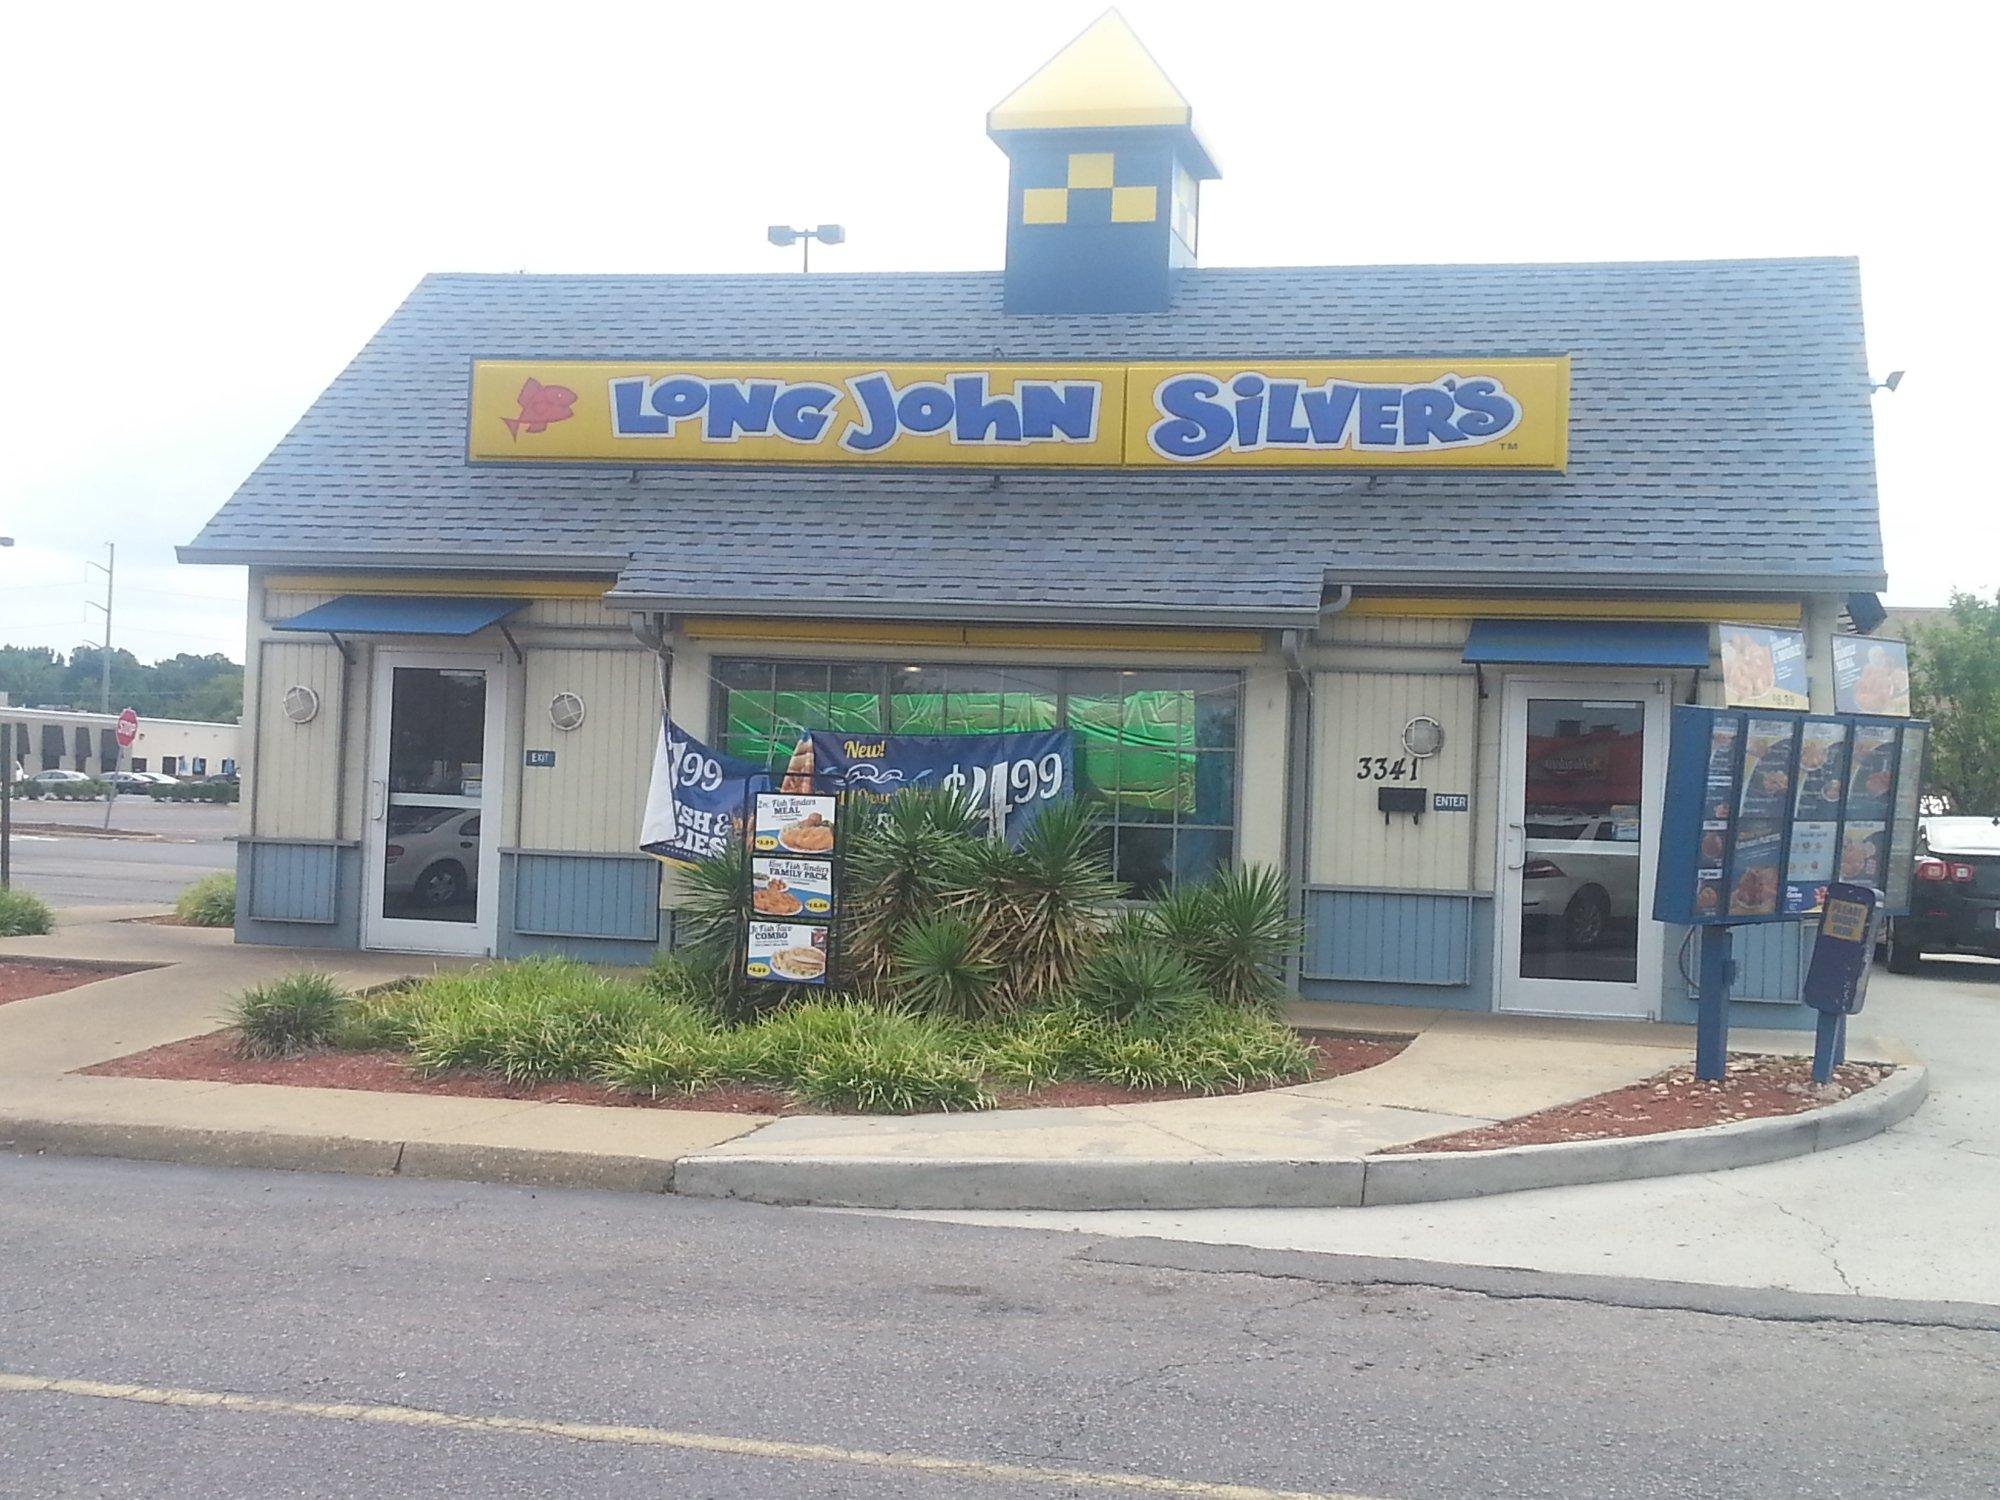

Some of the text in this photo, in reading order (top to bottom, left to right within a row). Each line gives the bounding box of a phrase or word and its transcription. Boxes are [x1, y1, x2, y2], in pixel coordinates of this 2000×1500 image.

[118, 719, 137, 736] STOP
[844, 740, 886, 759] New!
[531, 752, 549, 763] EXIT
[1357, 757, 1418, 781] 3341
[1435, 796, 1466, 807] ENTER
[774, 806, 800, 814] MEAL
[714, 813, 732, 836] &
[785, 861, 801, 870] Fish
[769, 867, 828, 880] FAMILY PACK
[759, 924, 774, 932] Fish
[755, 932, 788, 940] COMBO
